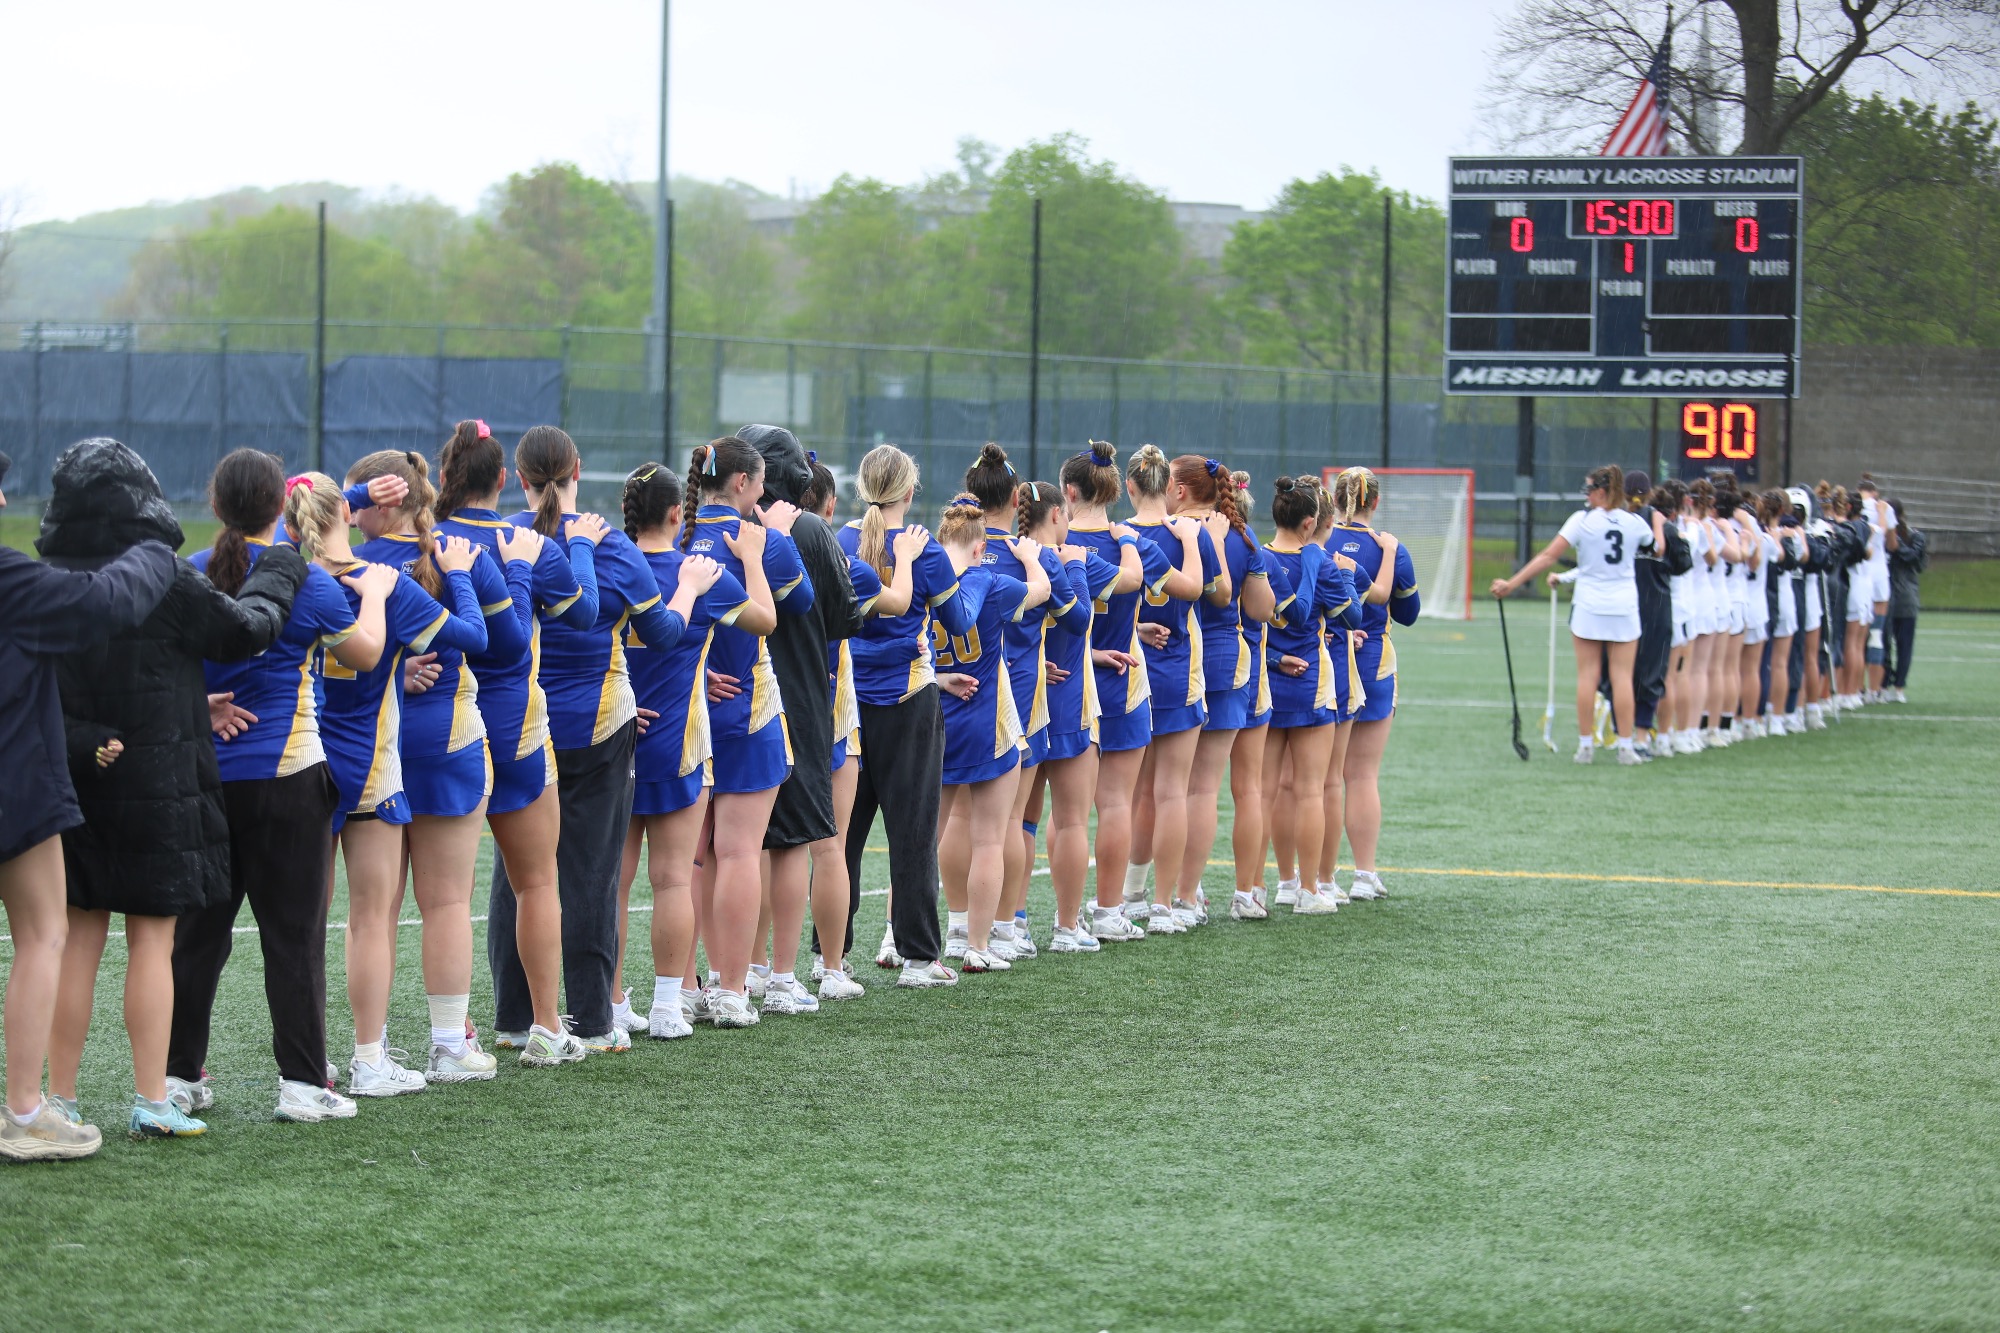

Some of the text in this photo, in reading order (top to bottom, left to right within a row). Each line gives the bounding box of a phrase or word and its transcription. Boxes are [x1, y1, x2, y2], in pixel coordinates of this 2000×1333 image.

[1453, 168, 1796, 185] WITMER FAMILY LACROSSE STADIUM
[1586, 200, 1675, 235] 15:00
[1714, 201, 1758, 217] GUESTS
[1510, 217, 1534, 253] 0
[1735, 217, 1759, 253] 0
[1454, 258, 1497, 275] PLAYER
[1527, 258, 1578, 275] PENALTY
[1624, 242, 1634, 273] 1
[1666, 258, 1716, 275] PENALTY
[1749, 258, 1790, 276] PLAYER
[1600, 279, 1644, 297] PERIOD
[1620, 368, 1788, 387] LACROSSE
[1684, 403, 1756, 459] 90
[1605, 530, 1623, 564] 3
[932, 619, 982, 667] 20
